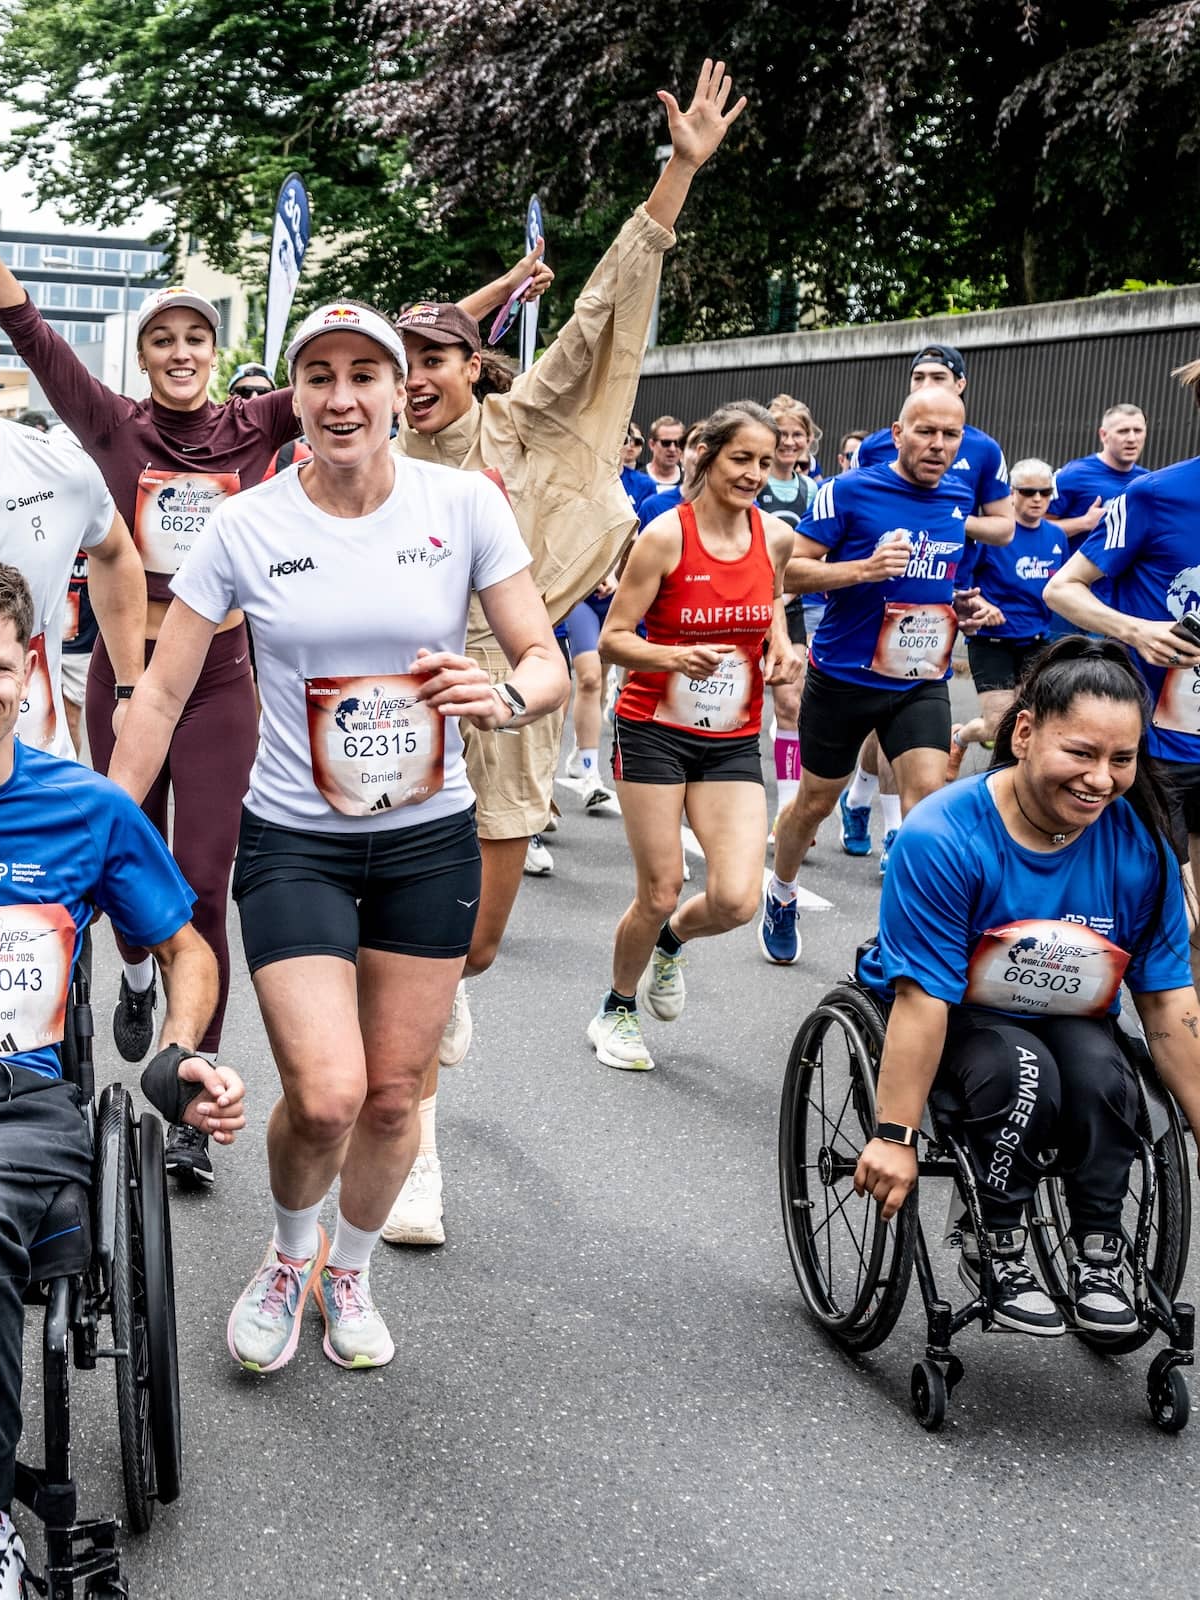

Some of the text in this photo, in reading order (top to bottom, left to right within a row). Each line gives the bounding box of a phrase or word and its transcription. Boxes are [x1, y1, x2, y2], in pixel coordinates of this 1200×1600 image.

[17, 490, 55, 509] Sunrise
[177, 490, 209, 500] WINGS
[180, 498, 200, 506] LIFE
[161, 515, 205, 533] 6623
[397, 547, 453, 569] RYF Birds
[269, 557, 316, 578] HOKA
[693, 574, 711, 582] JAKO
[899, 635, 939, 649] 60676
[689, 678, 735, 697] 62571
[362, 699, 407, 711] WINGS
[368, 709, 394, 721] LIFE
[392, 718, 409, 729] 2026
[343, 731, 417, 758] 62315
[361, 770, 403, 784] Daniela
[1039, 941, 1083, 957] WINGS
[16, 952, 35, 963] 2026
[1040, 950, 1067, 963] LIFE
[1061, 963, 1081, 974] 2026
[1004, 966, 1082, 995] 66303
[1011, 993, 1049, 1008] Wayra
[1008, 1045, 1040, 1129] ARMEE
